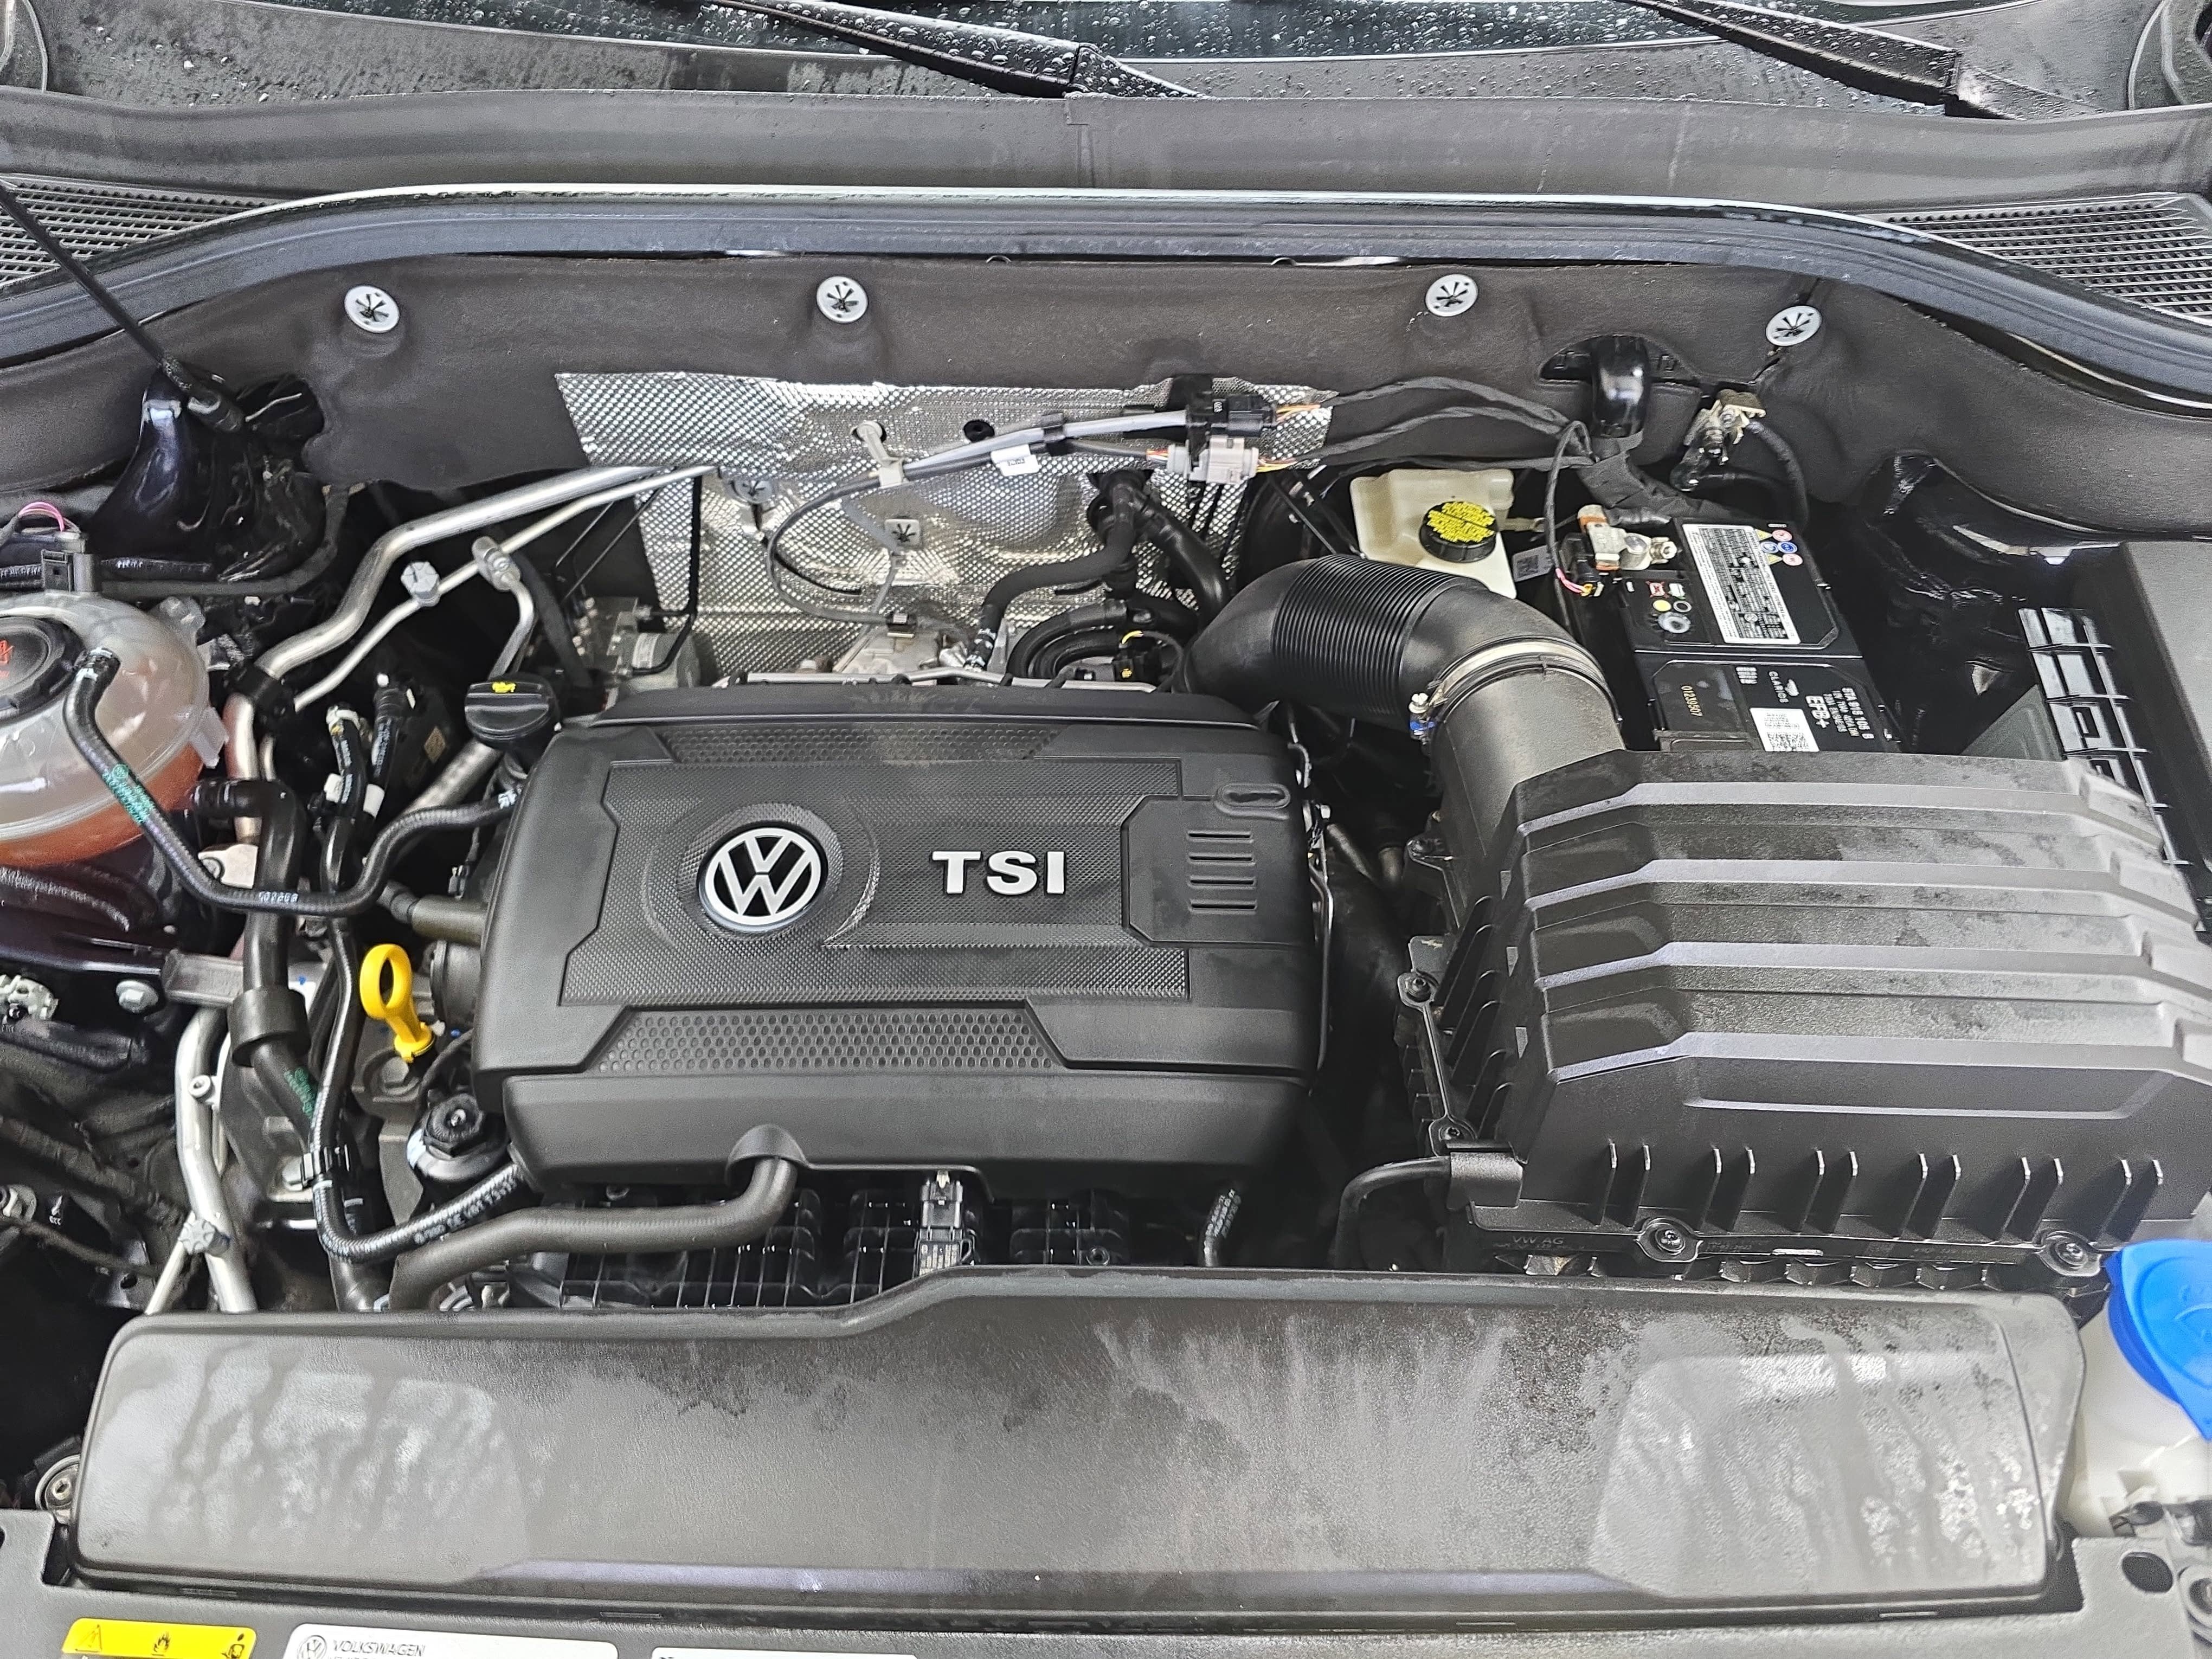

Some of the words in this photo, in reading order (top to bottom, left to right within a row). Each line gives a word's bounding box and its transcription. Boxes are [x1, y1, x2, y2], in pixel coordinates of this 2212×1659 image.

[1769, 671, 1789, 703] CLARIOS
[1805, 696, 1831, 728] EFB+
[706, 827, 821, 925] VW
[931, 850, 1066, 895] TSI
[1513, 1236, 1539, 1244] VW
[1541, 1236, 1565, 1245] AG
[333, 1639, 426, 1657] VOLKSWAGEN
